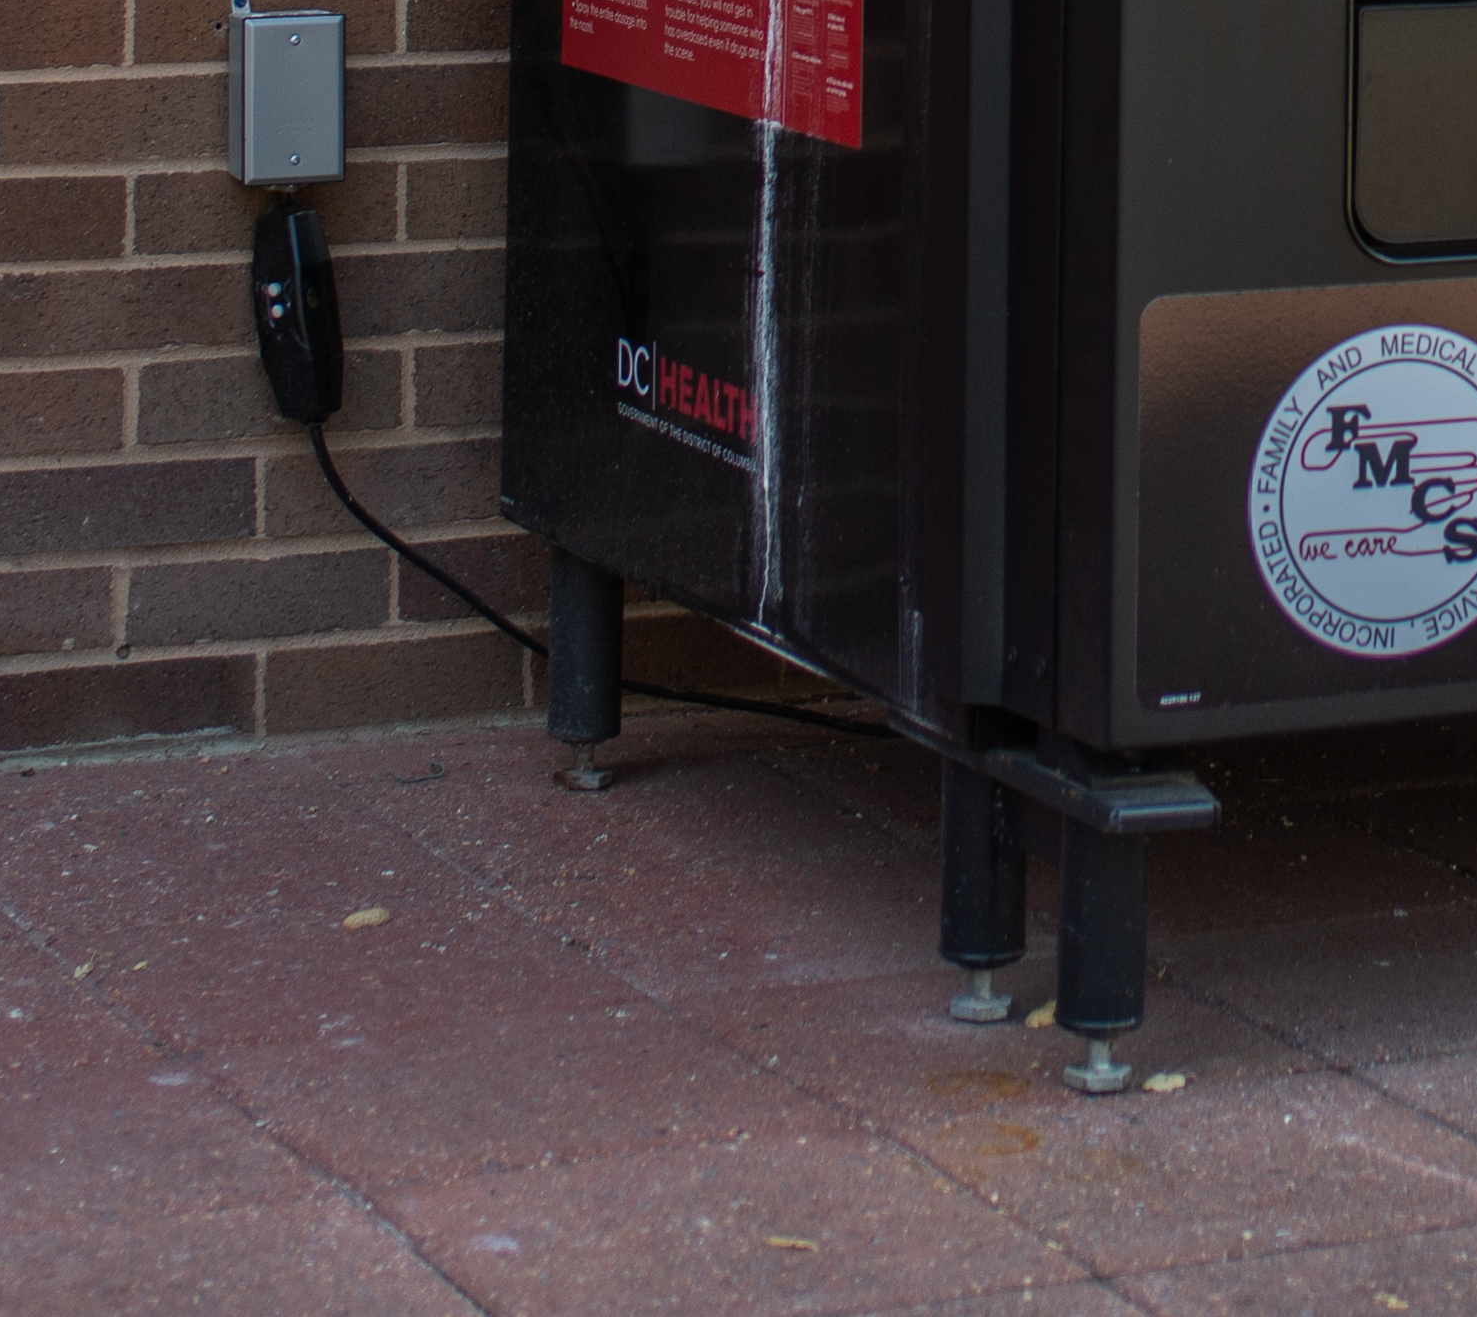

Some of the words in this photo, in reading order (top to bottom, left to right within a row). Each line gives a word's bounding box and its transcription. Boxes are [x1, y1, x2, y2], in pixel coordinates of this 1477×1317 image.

[1316, 346, 1362, 391] AND
[1381, 332, 1477, 376] MEDICAL
[618, 337, 650, 396] DC
[659, 356, 757, 445] HEALTH
[1258, 396, 1304, 494] FAMILY
[1300, 541, 1338, 561] we
[1344, 535, 1399, 559] care
[1259, 520, 1395, 649] INCORPORATED
